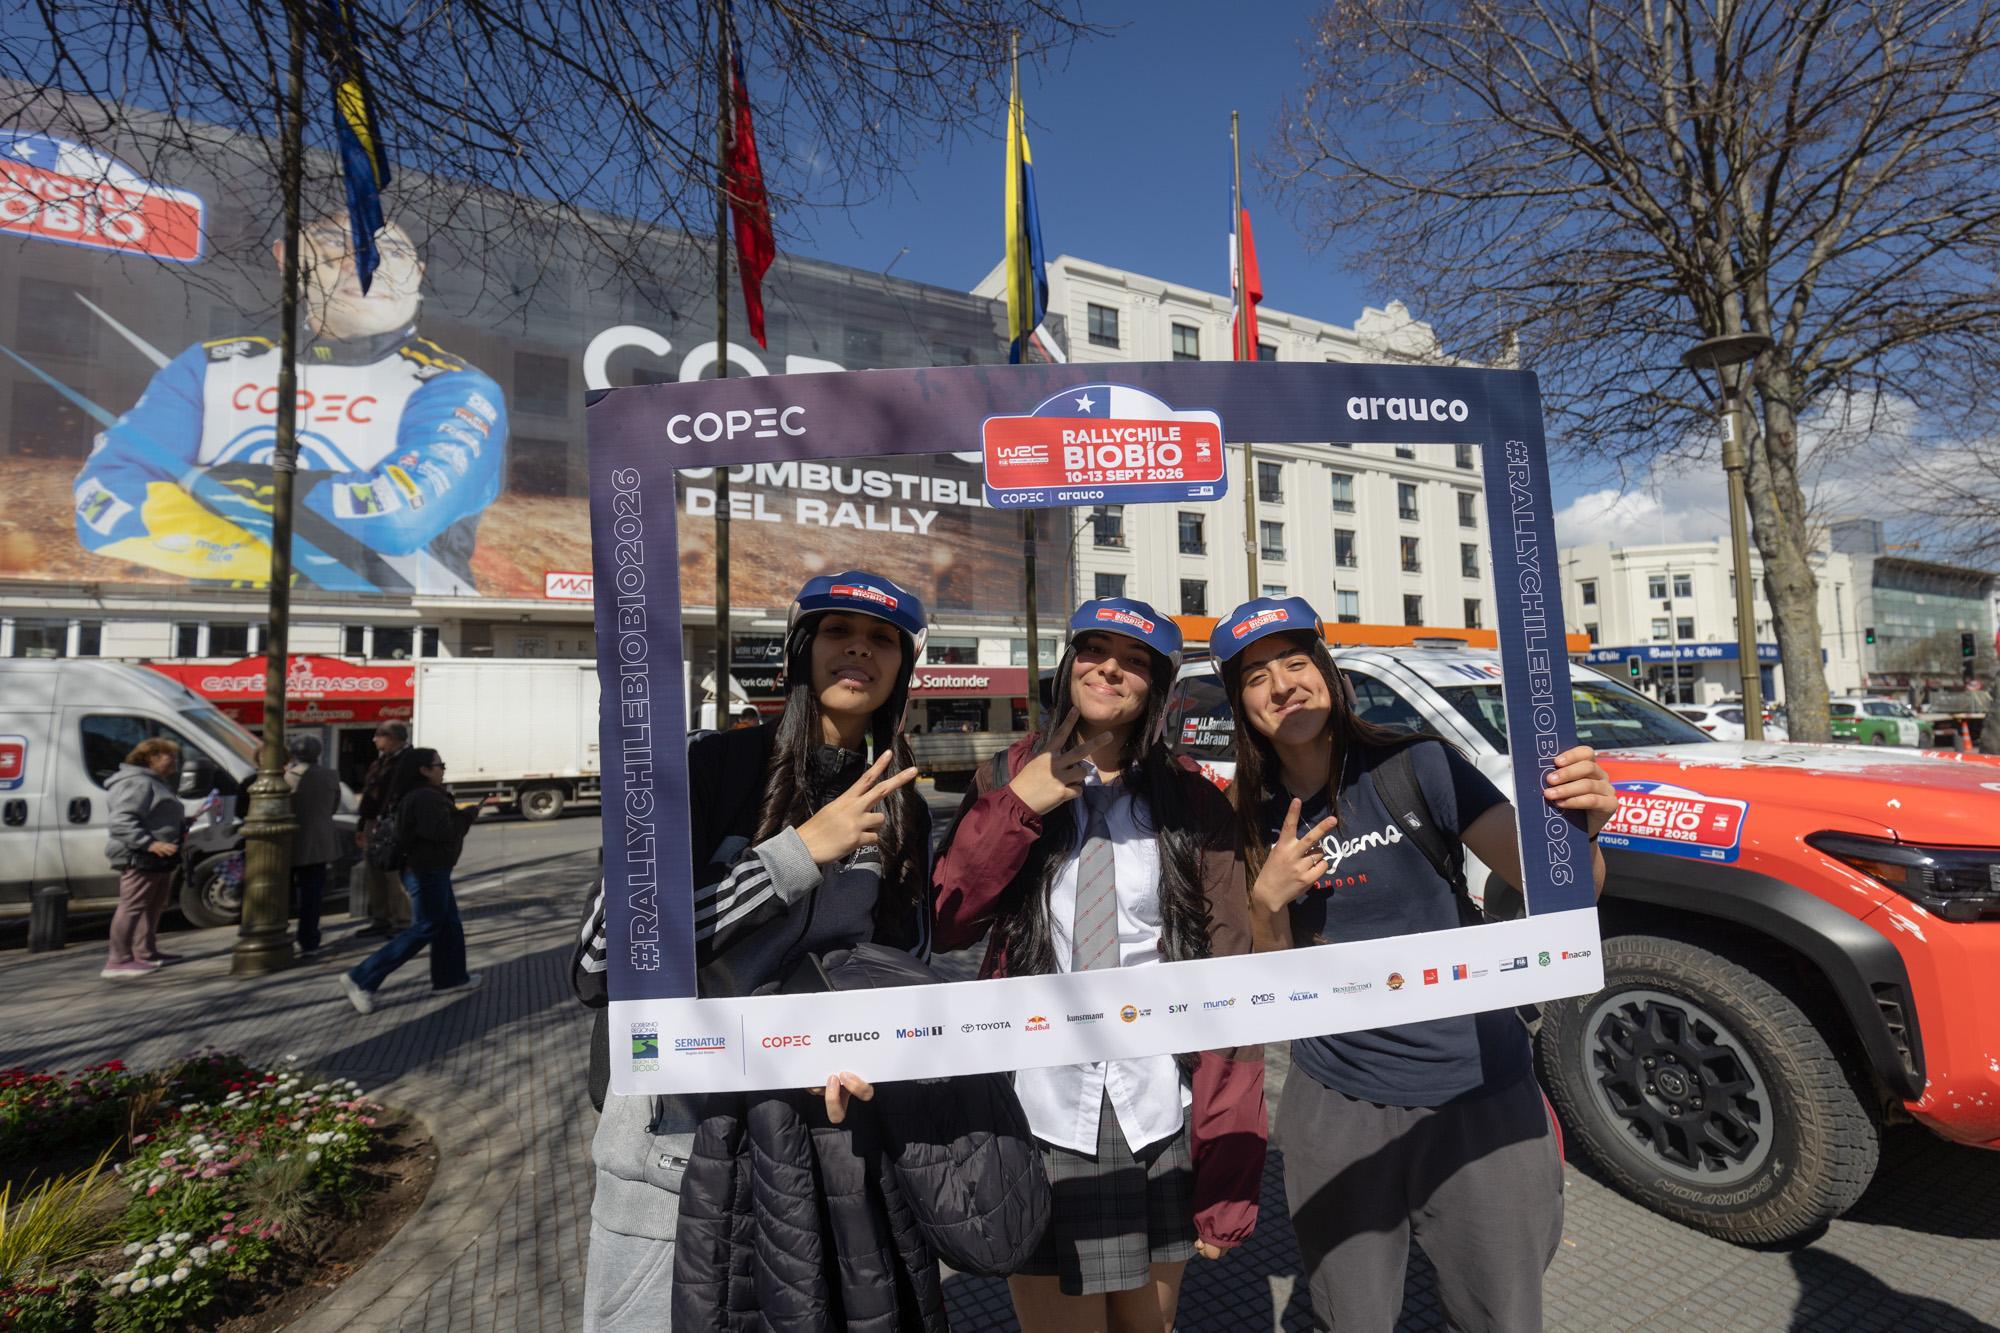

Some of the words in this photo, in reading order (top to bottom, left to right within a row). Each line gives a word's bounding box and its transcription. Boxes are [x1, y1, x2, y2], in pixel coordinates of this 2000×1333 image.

[1346, 396, 1469, 422] arauco
[666, 405, 808, 446] COPEC
[1062, 427, 1182, 445] RALLYCHILE
[997, 444, 1049, 458] WRC
[1065, 470, 1103, 483] 10-13
[1105, 469, 1144, 482] SEPT
[1147, 467, 1184, 480] 2026
[1001, 492, 1045, 504] COPEC
[1058, 489, 1105, 501] arauco
[685, 486, 782, 523] DEL
[796, 497, 939, 536] RALLY
[201, 674, 266, 692] CAFÉ
[286, 677, 388, 693] ARRASCO
[922, 674, 990, 689] Santander
[613, 467, 661, 971] #RALLYCHILEBIOBIO2026
[1196, 731, 1230, 746] J.Braun
[1617, 796, 1706, 815] ALLYCHILE
[1630, 824, 1663, 838] SEPT
[1664, 828, 1698, 842] 2026
[1322, 824, 1403, 875] Jeans
[896, 1026, 930, 1039] Mobil
[975, 1021, 1011, 1032] TOYOTA
[674, 1037, 726, 1048] SERNATUR
[761, 1034, 812, 1049] COPEC
[828, 1030, 881, 1044] arauco
